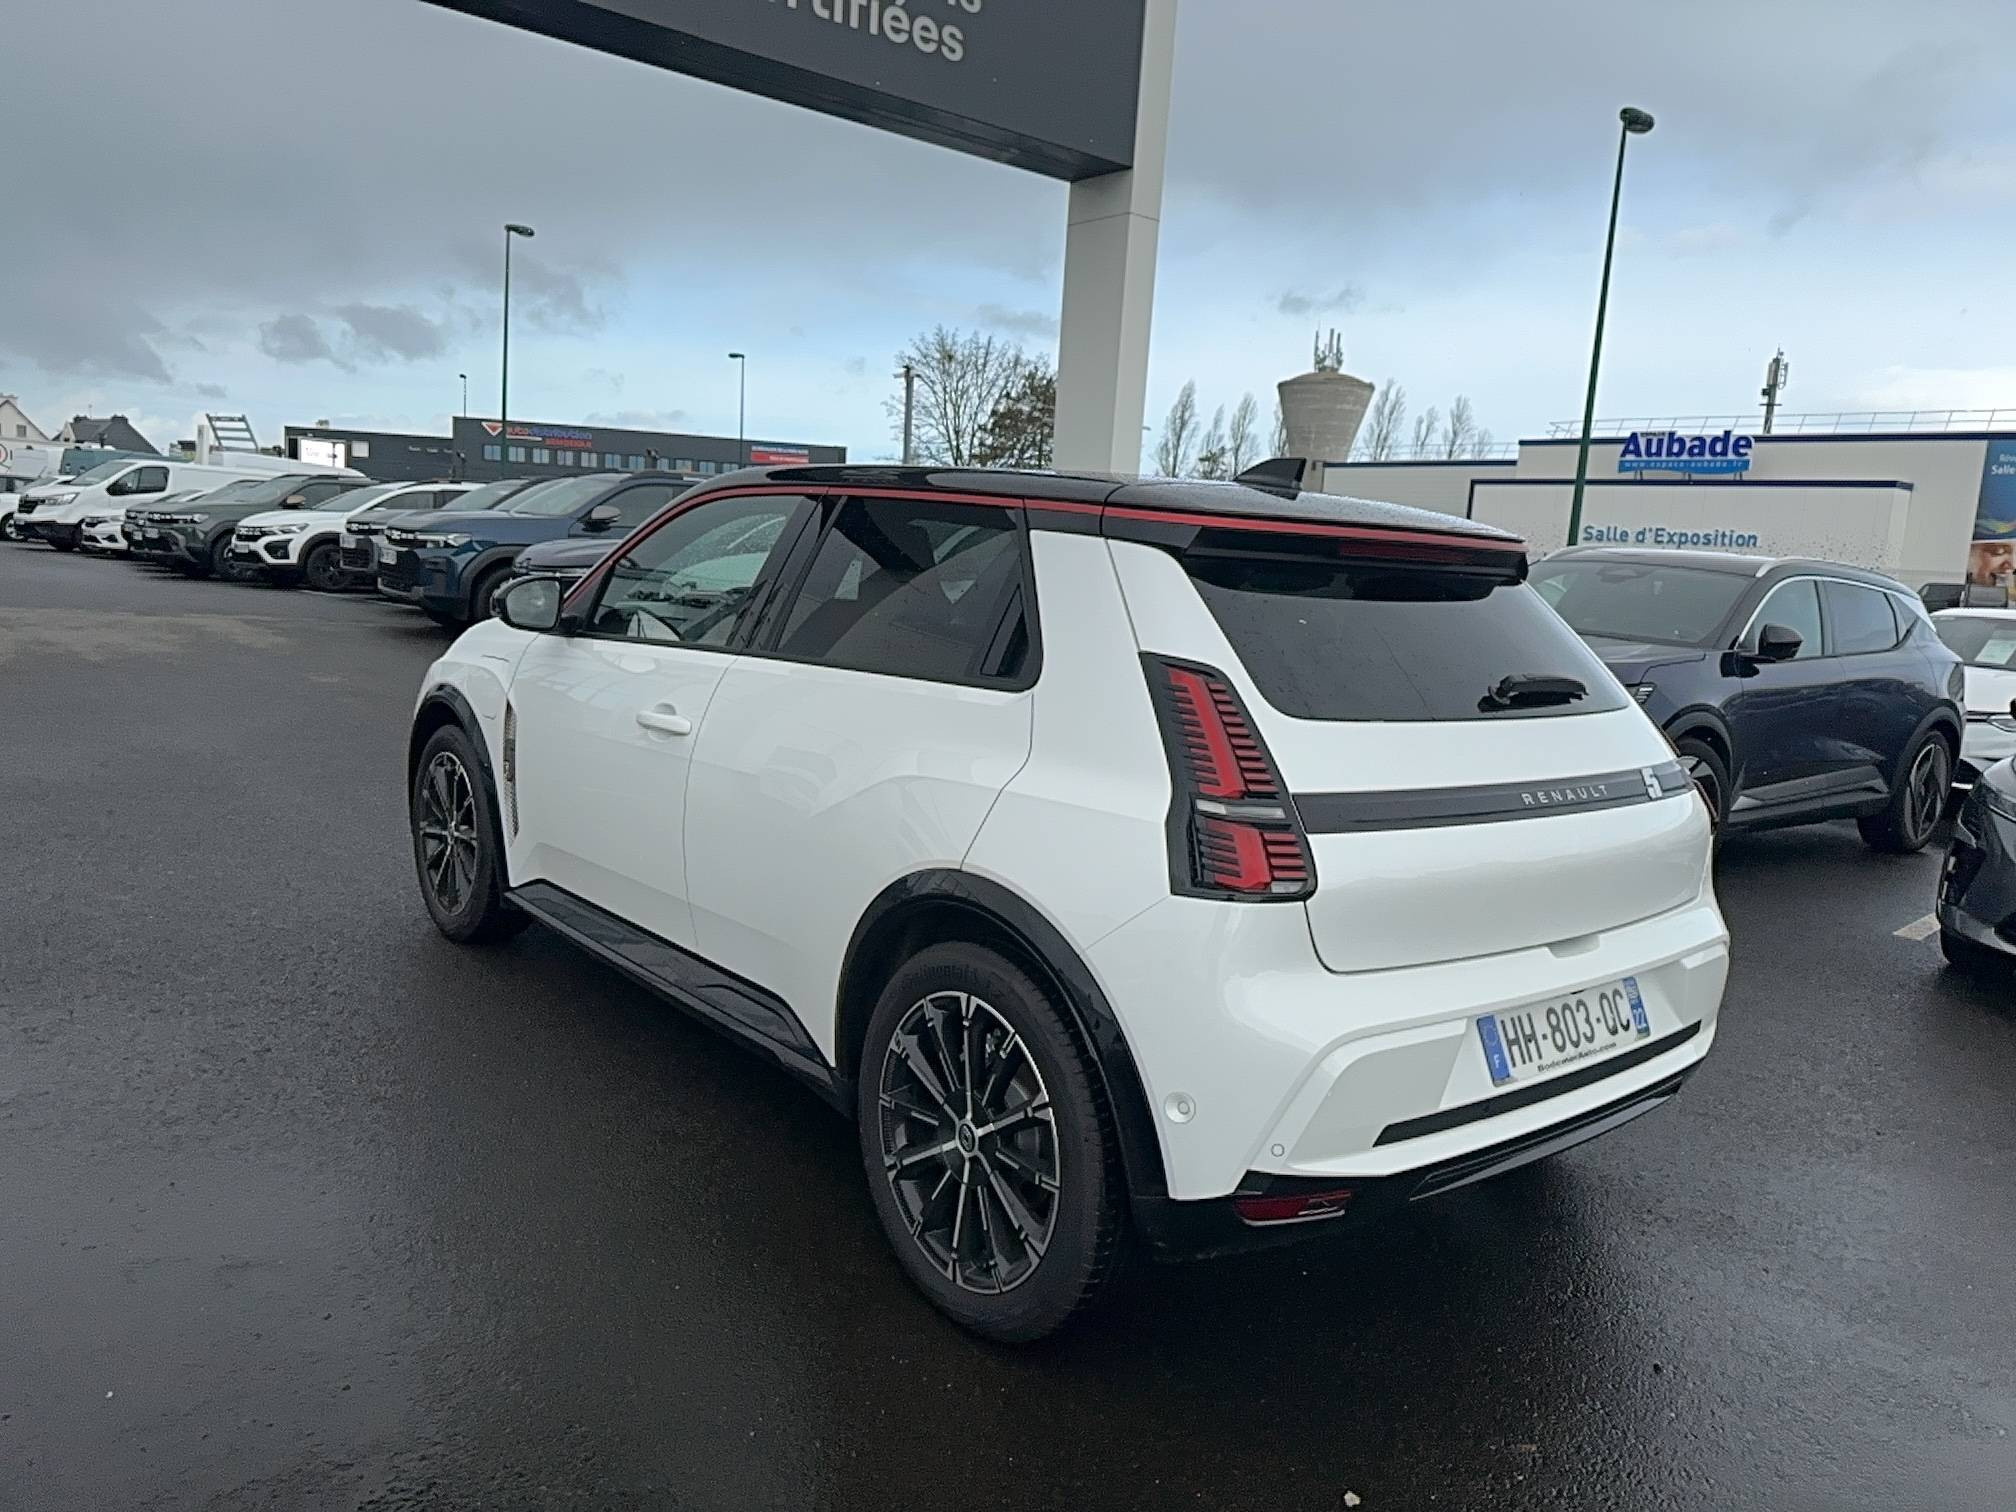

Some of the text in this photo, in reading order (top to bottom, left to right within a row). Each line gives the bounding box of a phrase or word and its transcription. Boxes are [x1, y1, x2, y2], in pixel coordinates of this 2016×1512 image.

[768, 0, 964, 62] ifiées
[1620, 430, 1753, 458] Aubade
[1583, 525, 1758, 548] Salle d'Exposition
[1521, 785, 1609, 805] RENAULT
